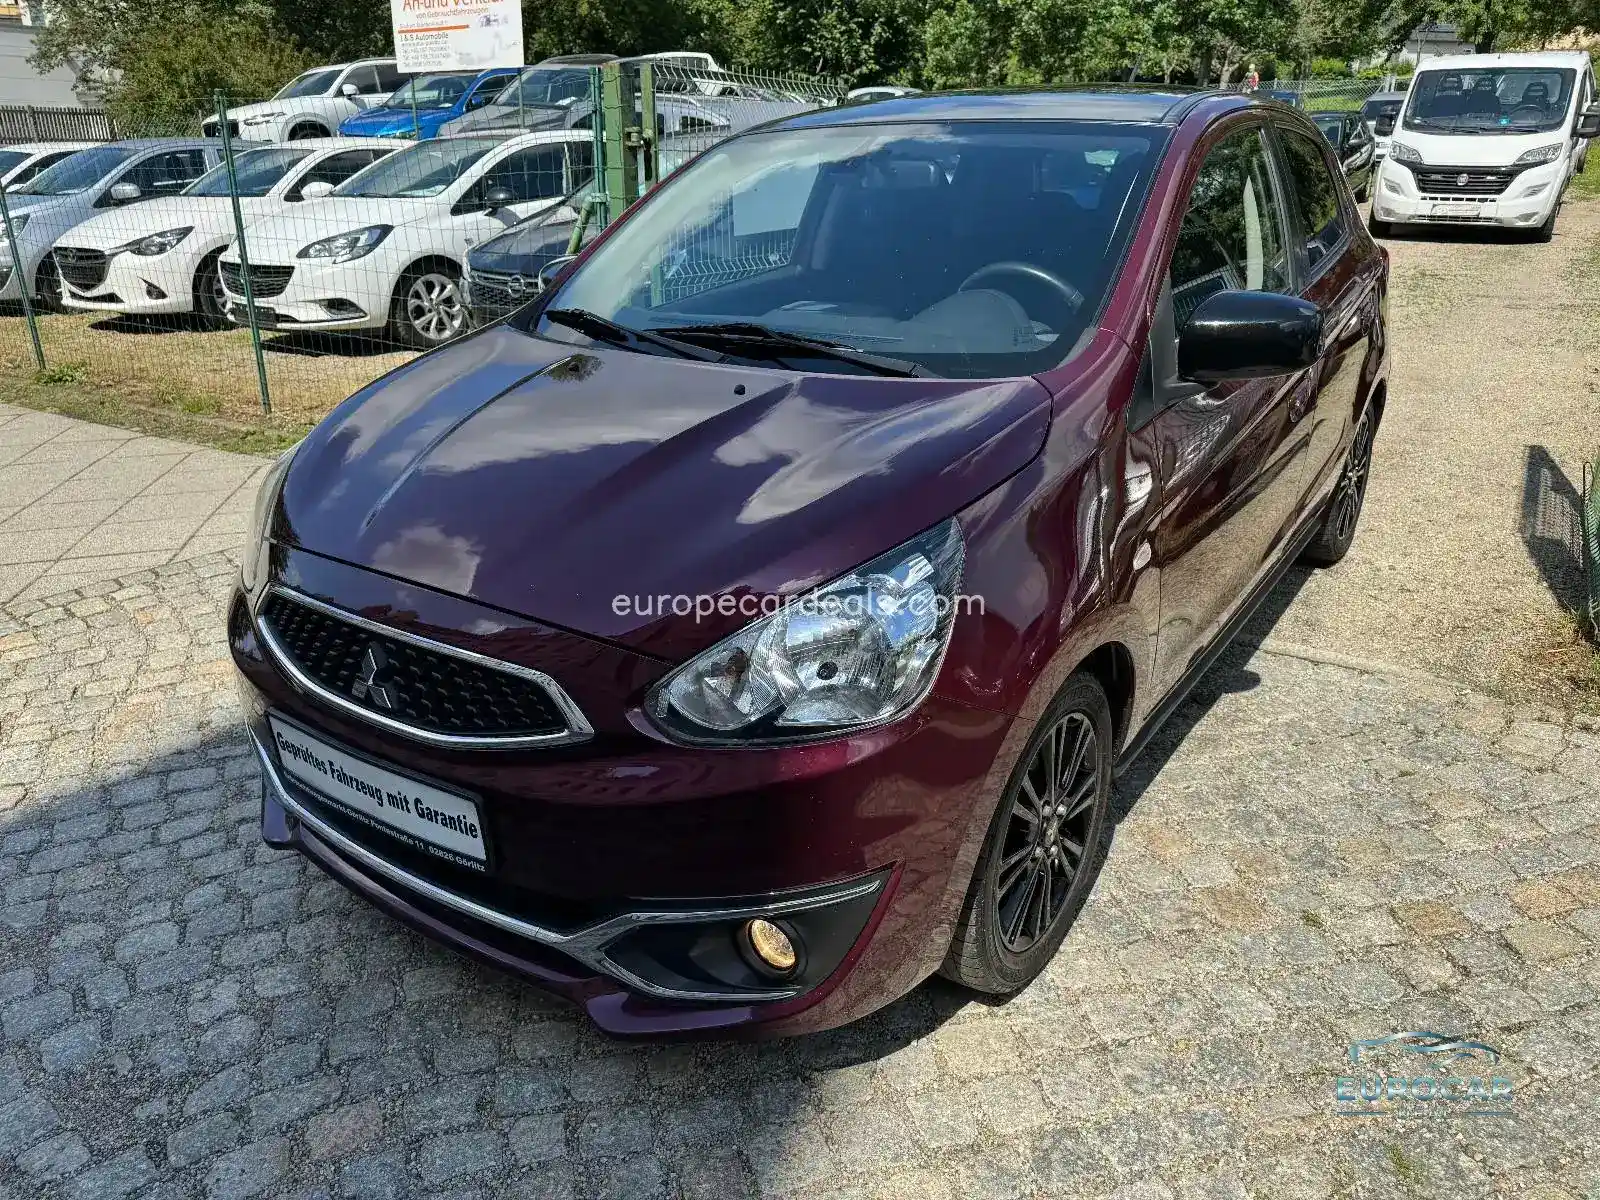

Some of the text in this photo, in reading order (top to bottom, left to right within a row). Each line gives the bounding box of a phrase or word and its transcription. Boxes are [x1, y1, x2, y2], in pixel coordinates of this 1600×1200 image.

[276, 731, 478, 838] Geprüftes Fahrzeug mit Garantie
[455, 855, 486, 872] Görlitz
